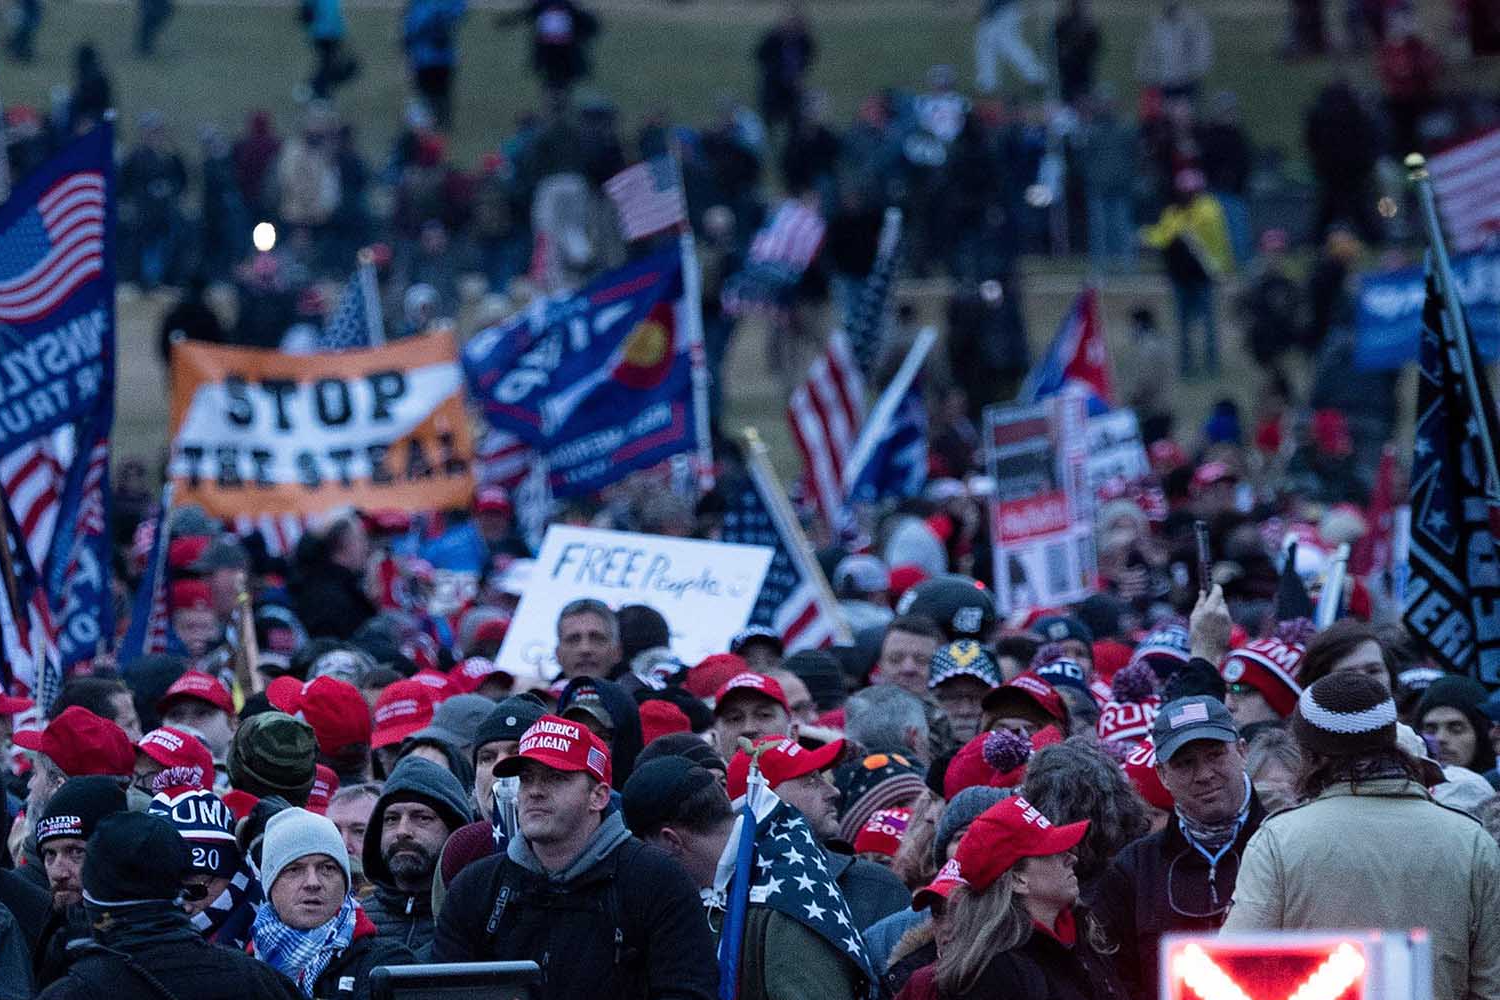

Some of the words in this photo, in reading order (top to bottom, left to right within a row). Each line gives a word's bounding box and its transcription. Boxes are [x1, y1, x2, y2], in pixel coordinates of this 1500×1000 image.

[226, 369, 406, 431] STOP
[182, 445, 275, 488] THE
[295, 432, 468, 488] STEAL
[551, 543, 645, 589] FREE
[535, 735, 570, 753] AGAIN
